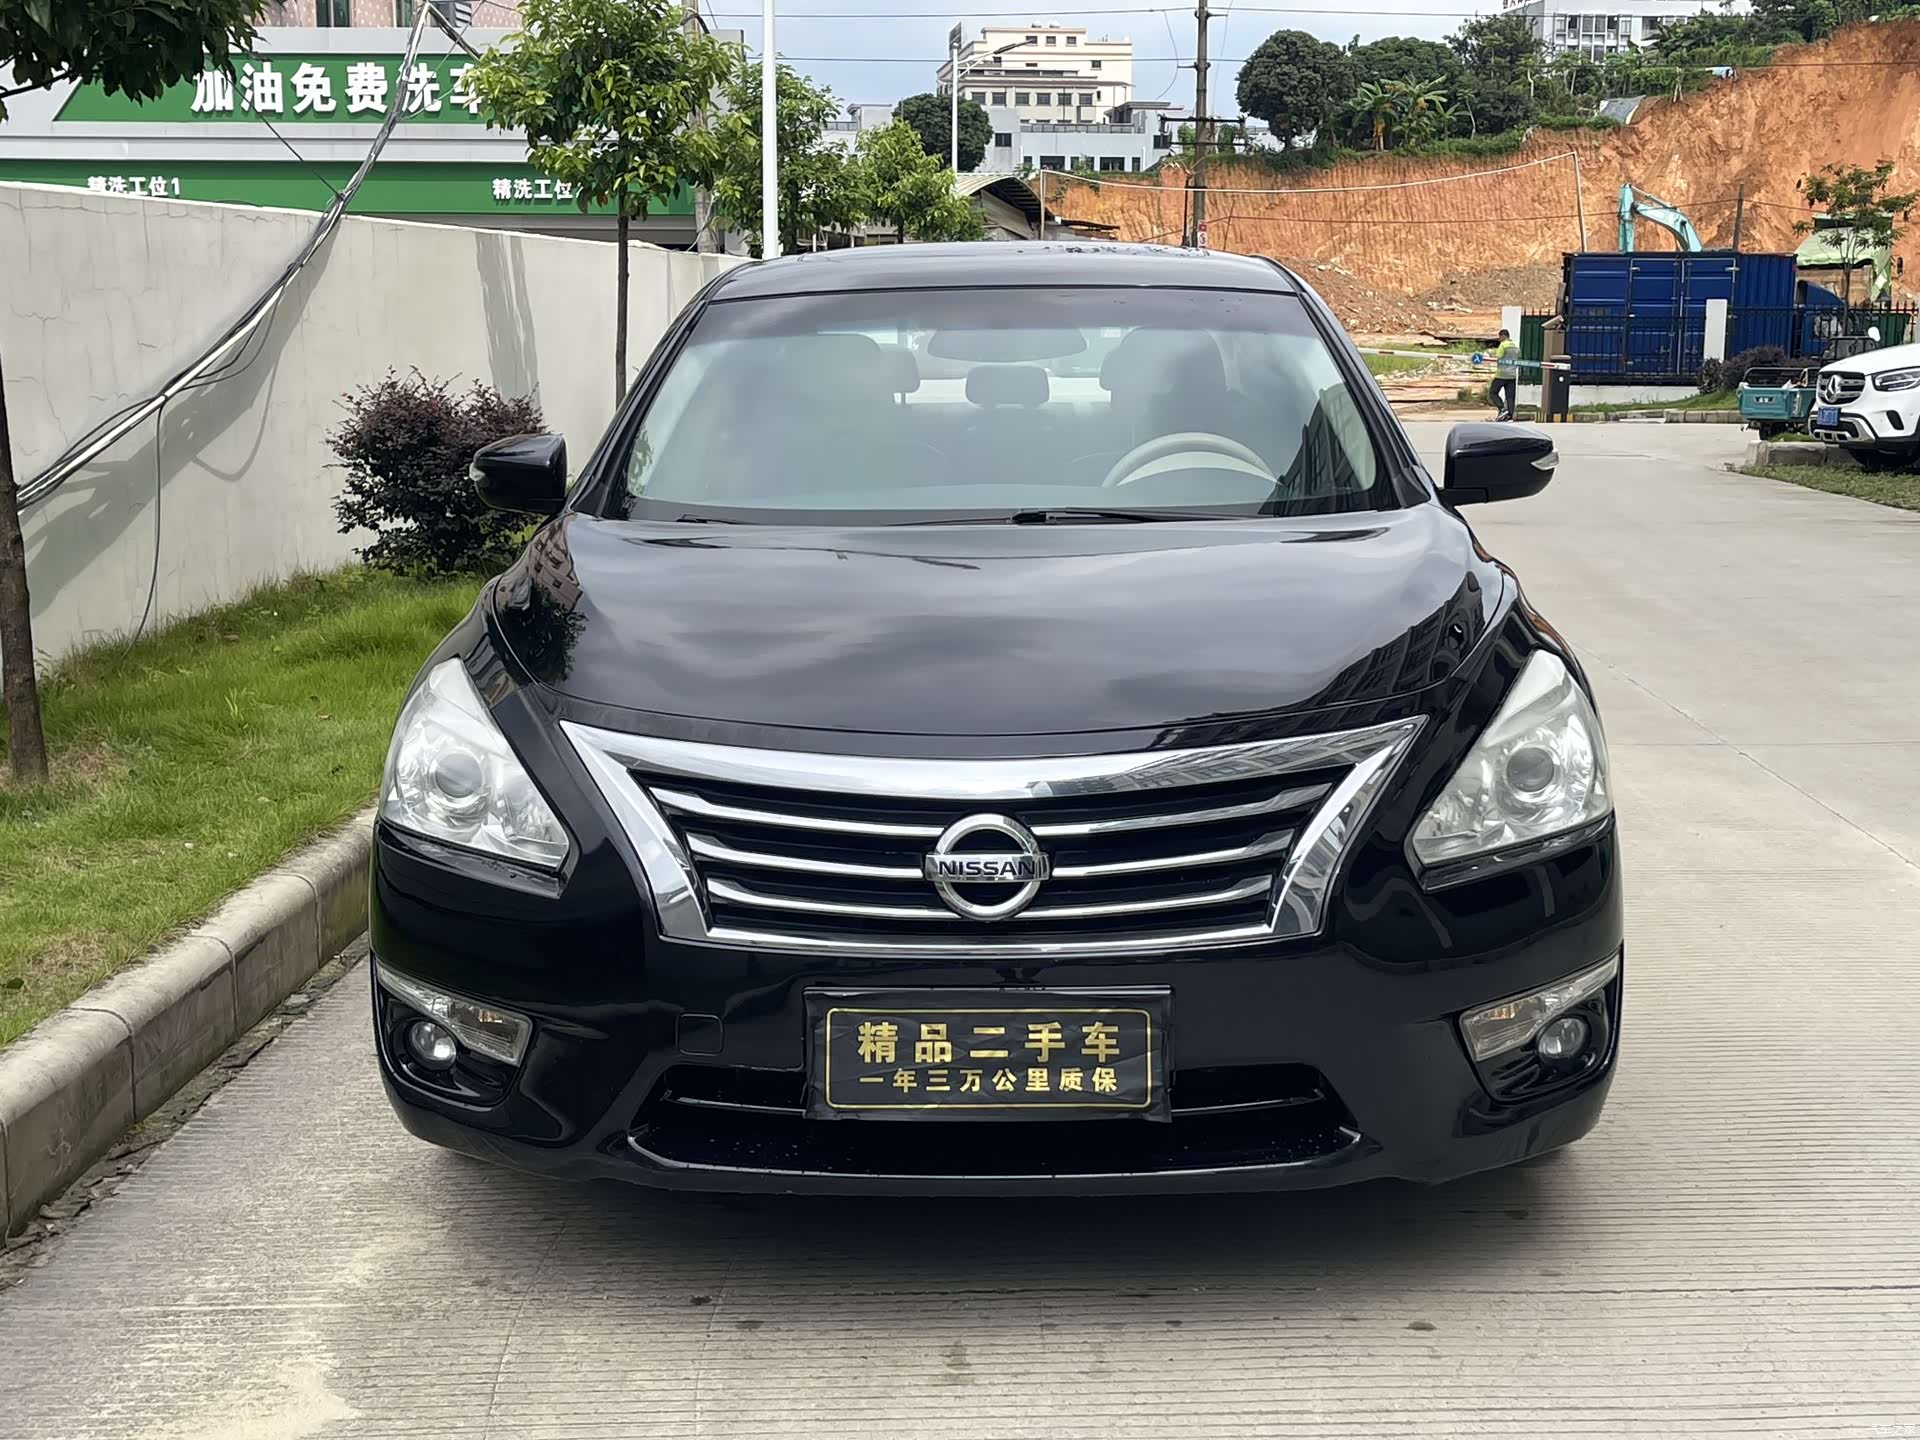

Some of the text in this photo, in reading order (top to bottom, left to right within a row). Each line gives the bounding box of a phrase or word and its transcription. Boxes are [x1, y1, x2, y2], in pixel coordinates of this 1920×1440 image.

[938, 860, 1036, 876] NISSAN
[857, 1021, 1120, 1063] 精品二手车
[859, 1067, 1118, 1093] 一年三万公里质保
